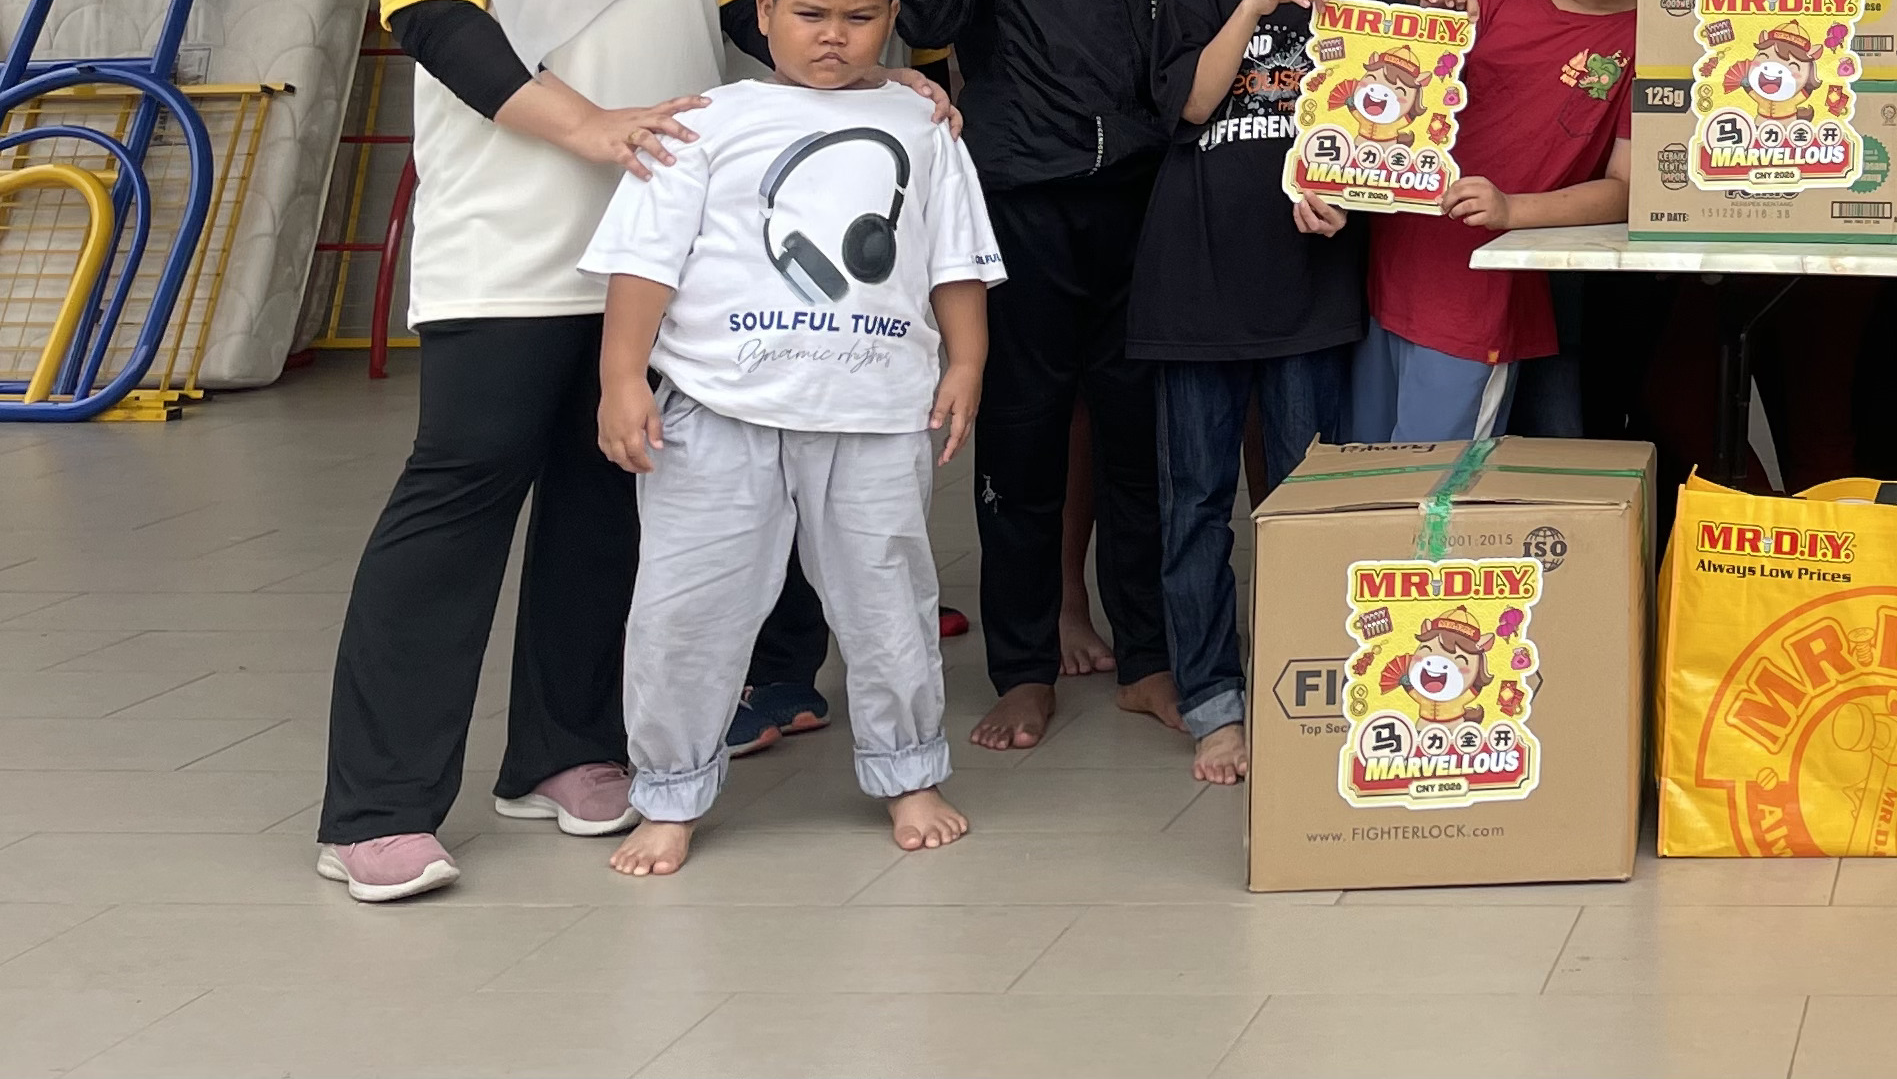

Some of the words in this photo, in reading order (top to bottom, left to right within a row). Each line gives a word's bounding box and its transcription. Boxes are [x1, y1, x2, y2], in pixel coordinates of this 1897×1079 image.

[1645, 86, 1685, 107] 125g
[1716, 117, 1839, 144] 马力全开
[1314, 134, 1437, 169] 马力全开
[1710, 145, 1845, 168] MARVELLOUS
[1306, 161, 1441, 192] MARVELLOUS
[1754, 172, 1773, 180] CNY
[1348, 190, 1366, 199] CNY
[1650, 212, 1666, 222] EXP
[1666, 212, 1690, 222] DATE:
[729, 311, 840, 332] SOULFUL
[851, 314, 911, 338] TUNES
[737, 338, 833, 373] Dynamic
[1523, 540, 1568, 558] ISO
[1696, 558, 1756, 578] Always
[1760, 564, 1794, 580] Low
[1797, 567, 1852, 583] Prices
[1300, 723, 1322, 736] Top
[1370, 722, 1513, 754] 马力全开
[1365, 749, 1520, 781] MARVELLOUS
[1415, 782, 1437, 794] CNY
